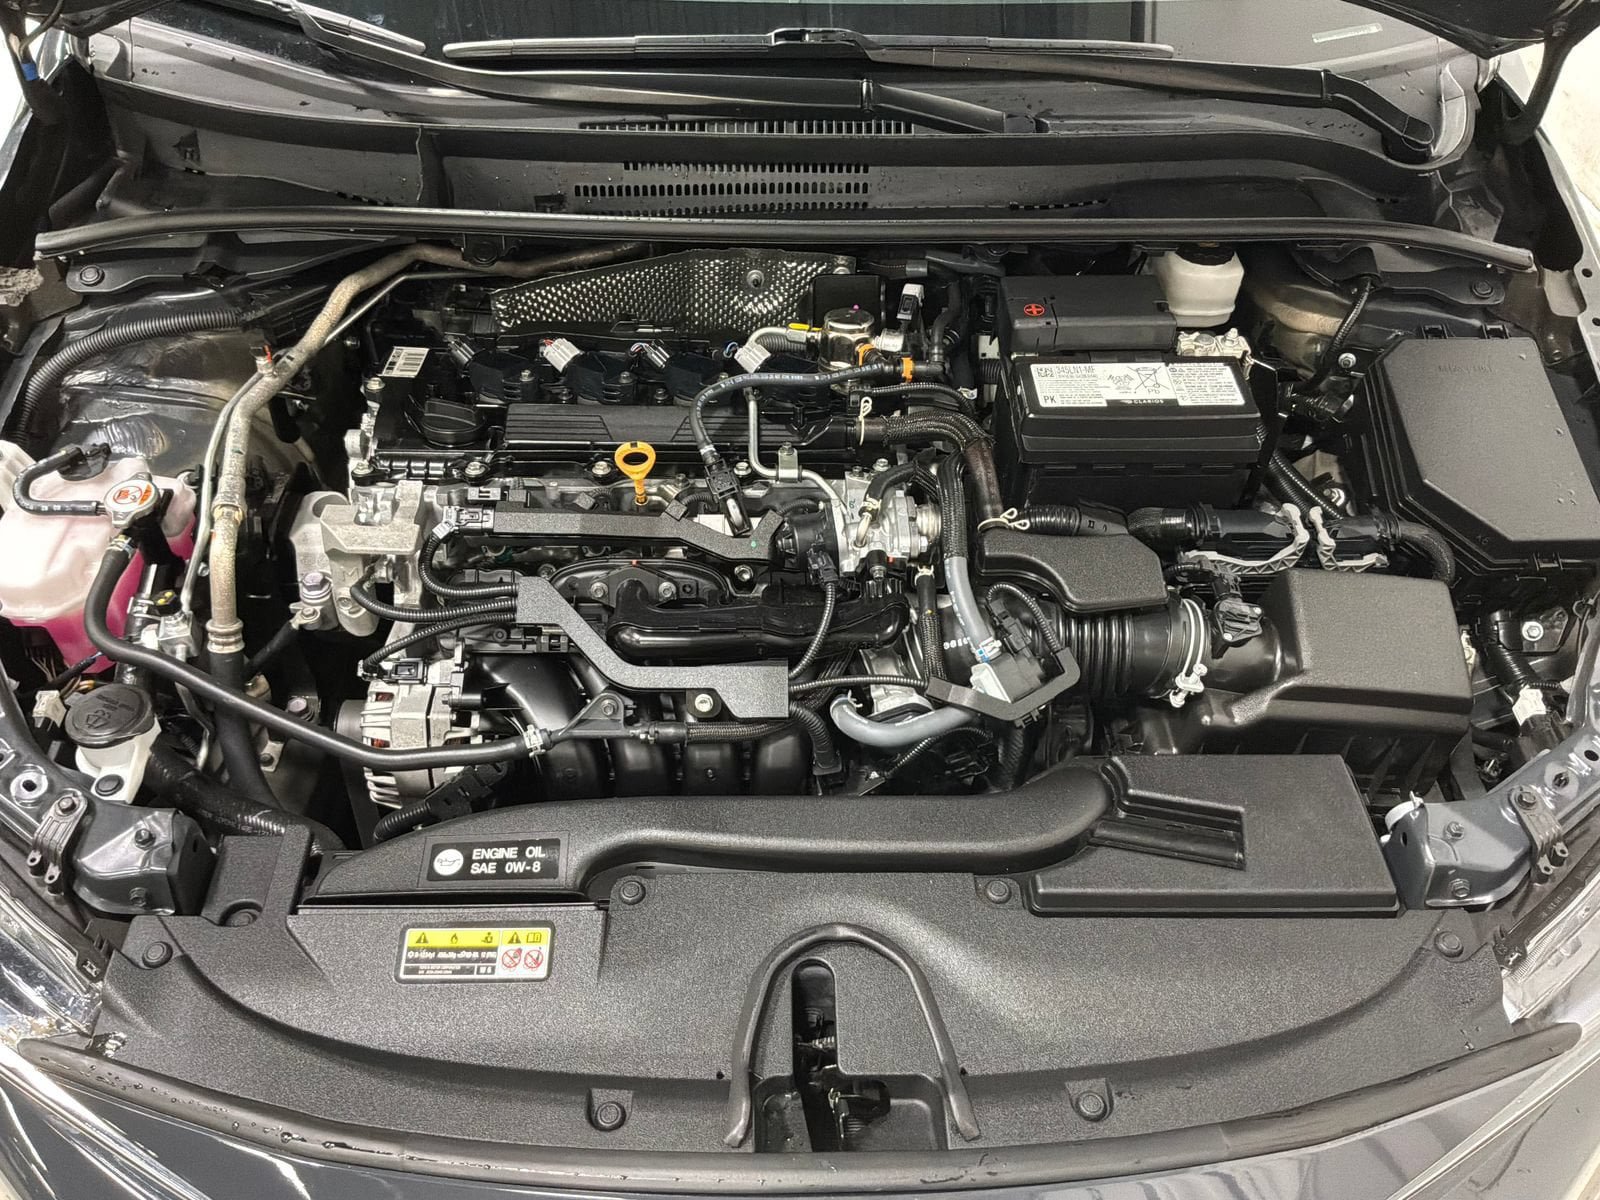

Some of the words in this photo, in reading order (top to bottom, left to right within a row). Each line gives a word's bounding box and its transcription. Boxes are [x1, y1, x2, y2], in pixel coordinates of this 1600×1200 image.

[1043, 395, 1056, 404] PK
[472, 847, 519, 860] ENGINE
[525, 846, 546, 859] OIL
[470, 862, 497, 875] SAE
[504, 861, 541, 874] 0W-8
